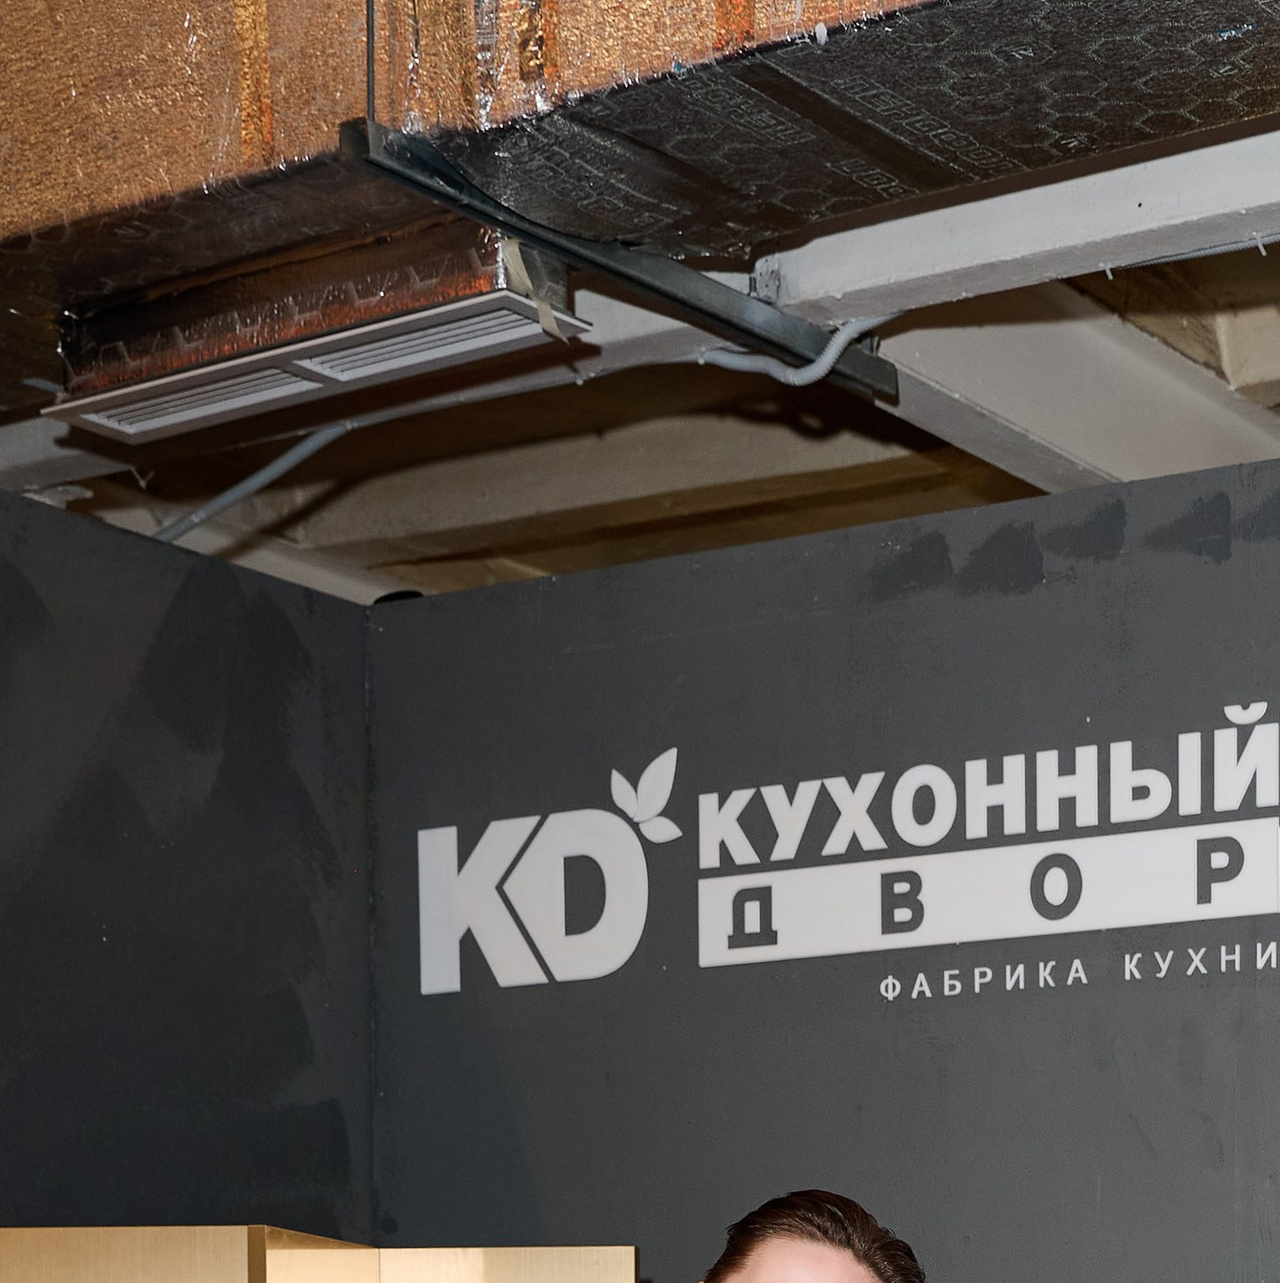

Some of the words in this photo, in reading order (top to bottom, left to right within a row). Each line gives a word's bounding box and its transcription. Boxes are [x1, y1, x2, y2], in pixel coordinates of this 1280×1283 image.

[698, 701, 1280, 870] КУХОННЫЙ
[417, 808, 649, 996] KD
[727, 836, 1245, 951] ДВОР
[879, 956, 1088, 1002] ФАБРИКА
[1123, 942, 1279, 982] КУХНИ
